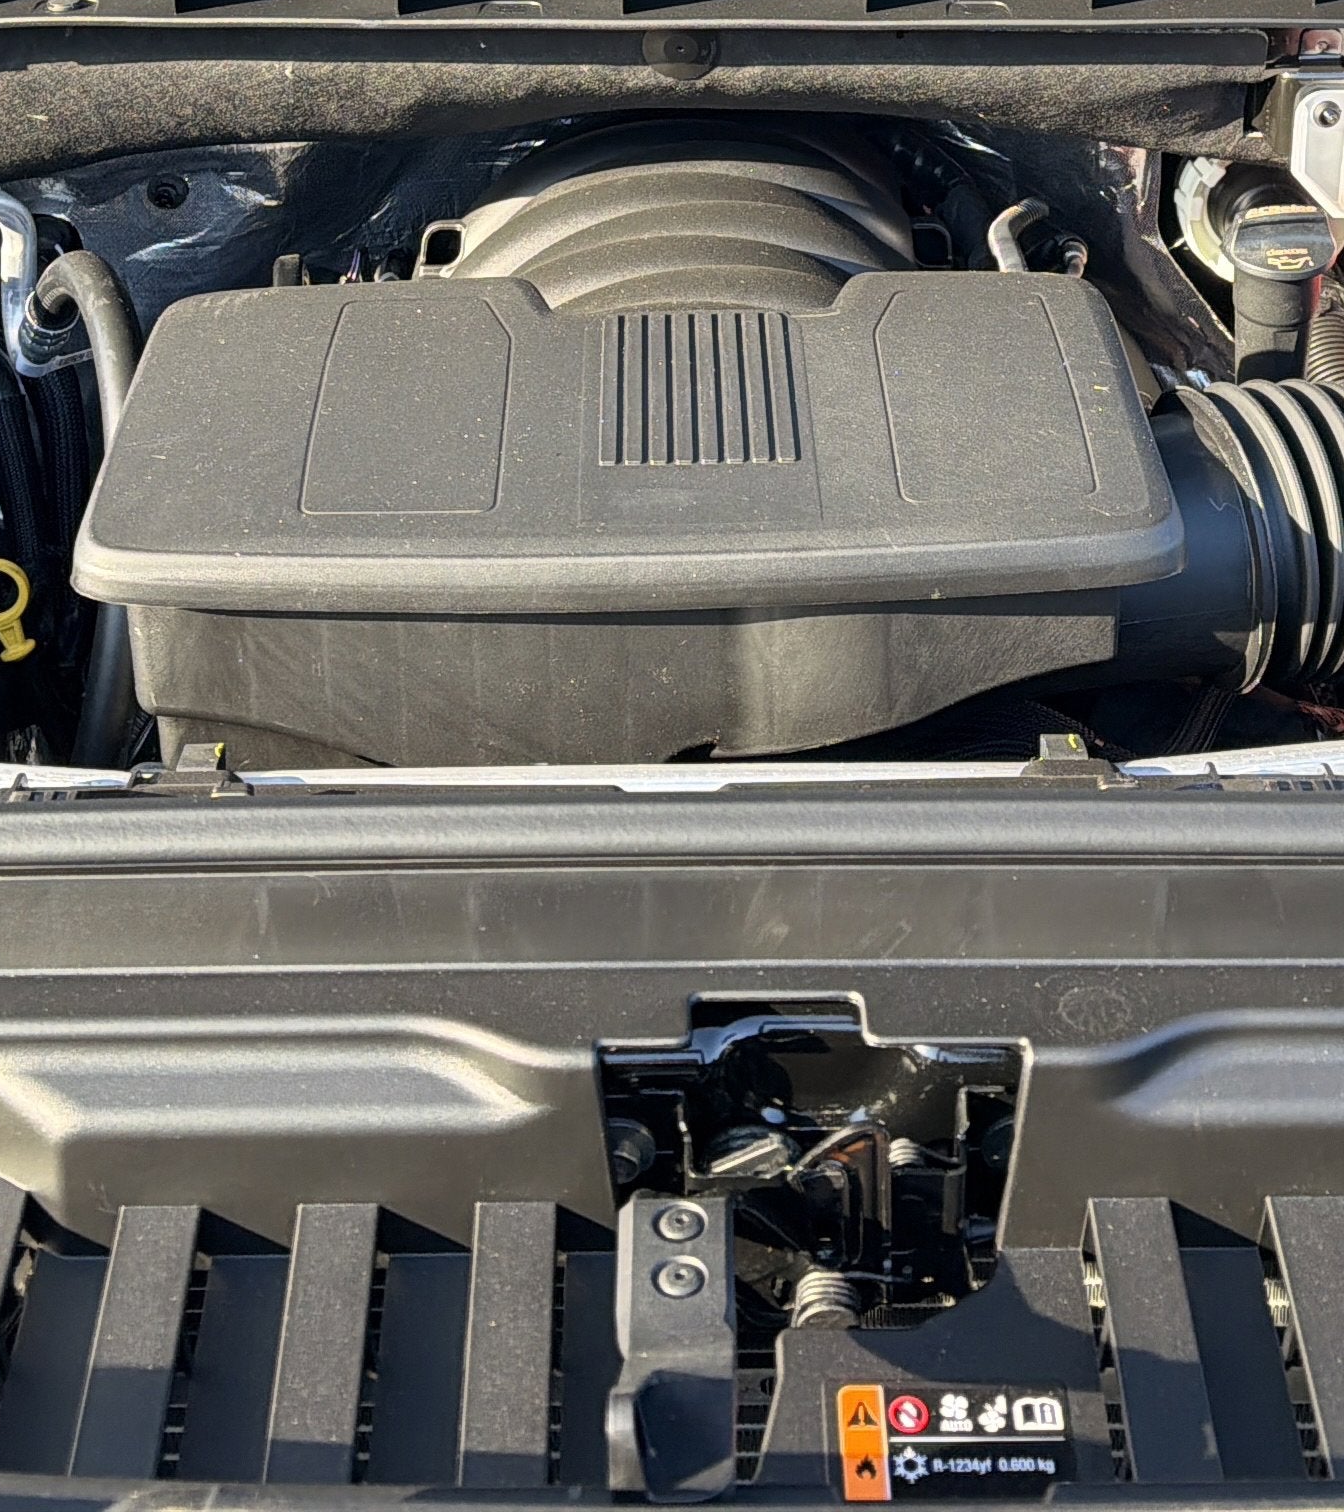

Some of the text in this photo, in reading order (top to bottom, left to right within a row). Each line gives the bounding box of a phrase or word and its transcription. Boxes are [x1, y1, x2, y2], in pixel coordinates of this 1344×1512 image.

[939, 1419, 973, 1432] AUTO
[932, 1457, 992, 1475] R-1234yf
[1037, 1457, 1056, 1474] kg
